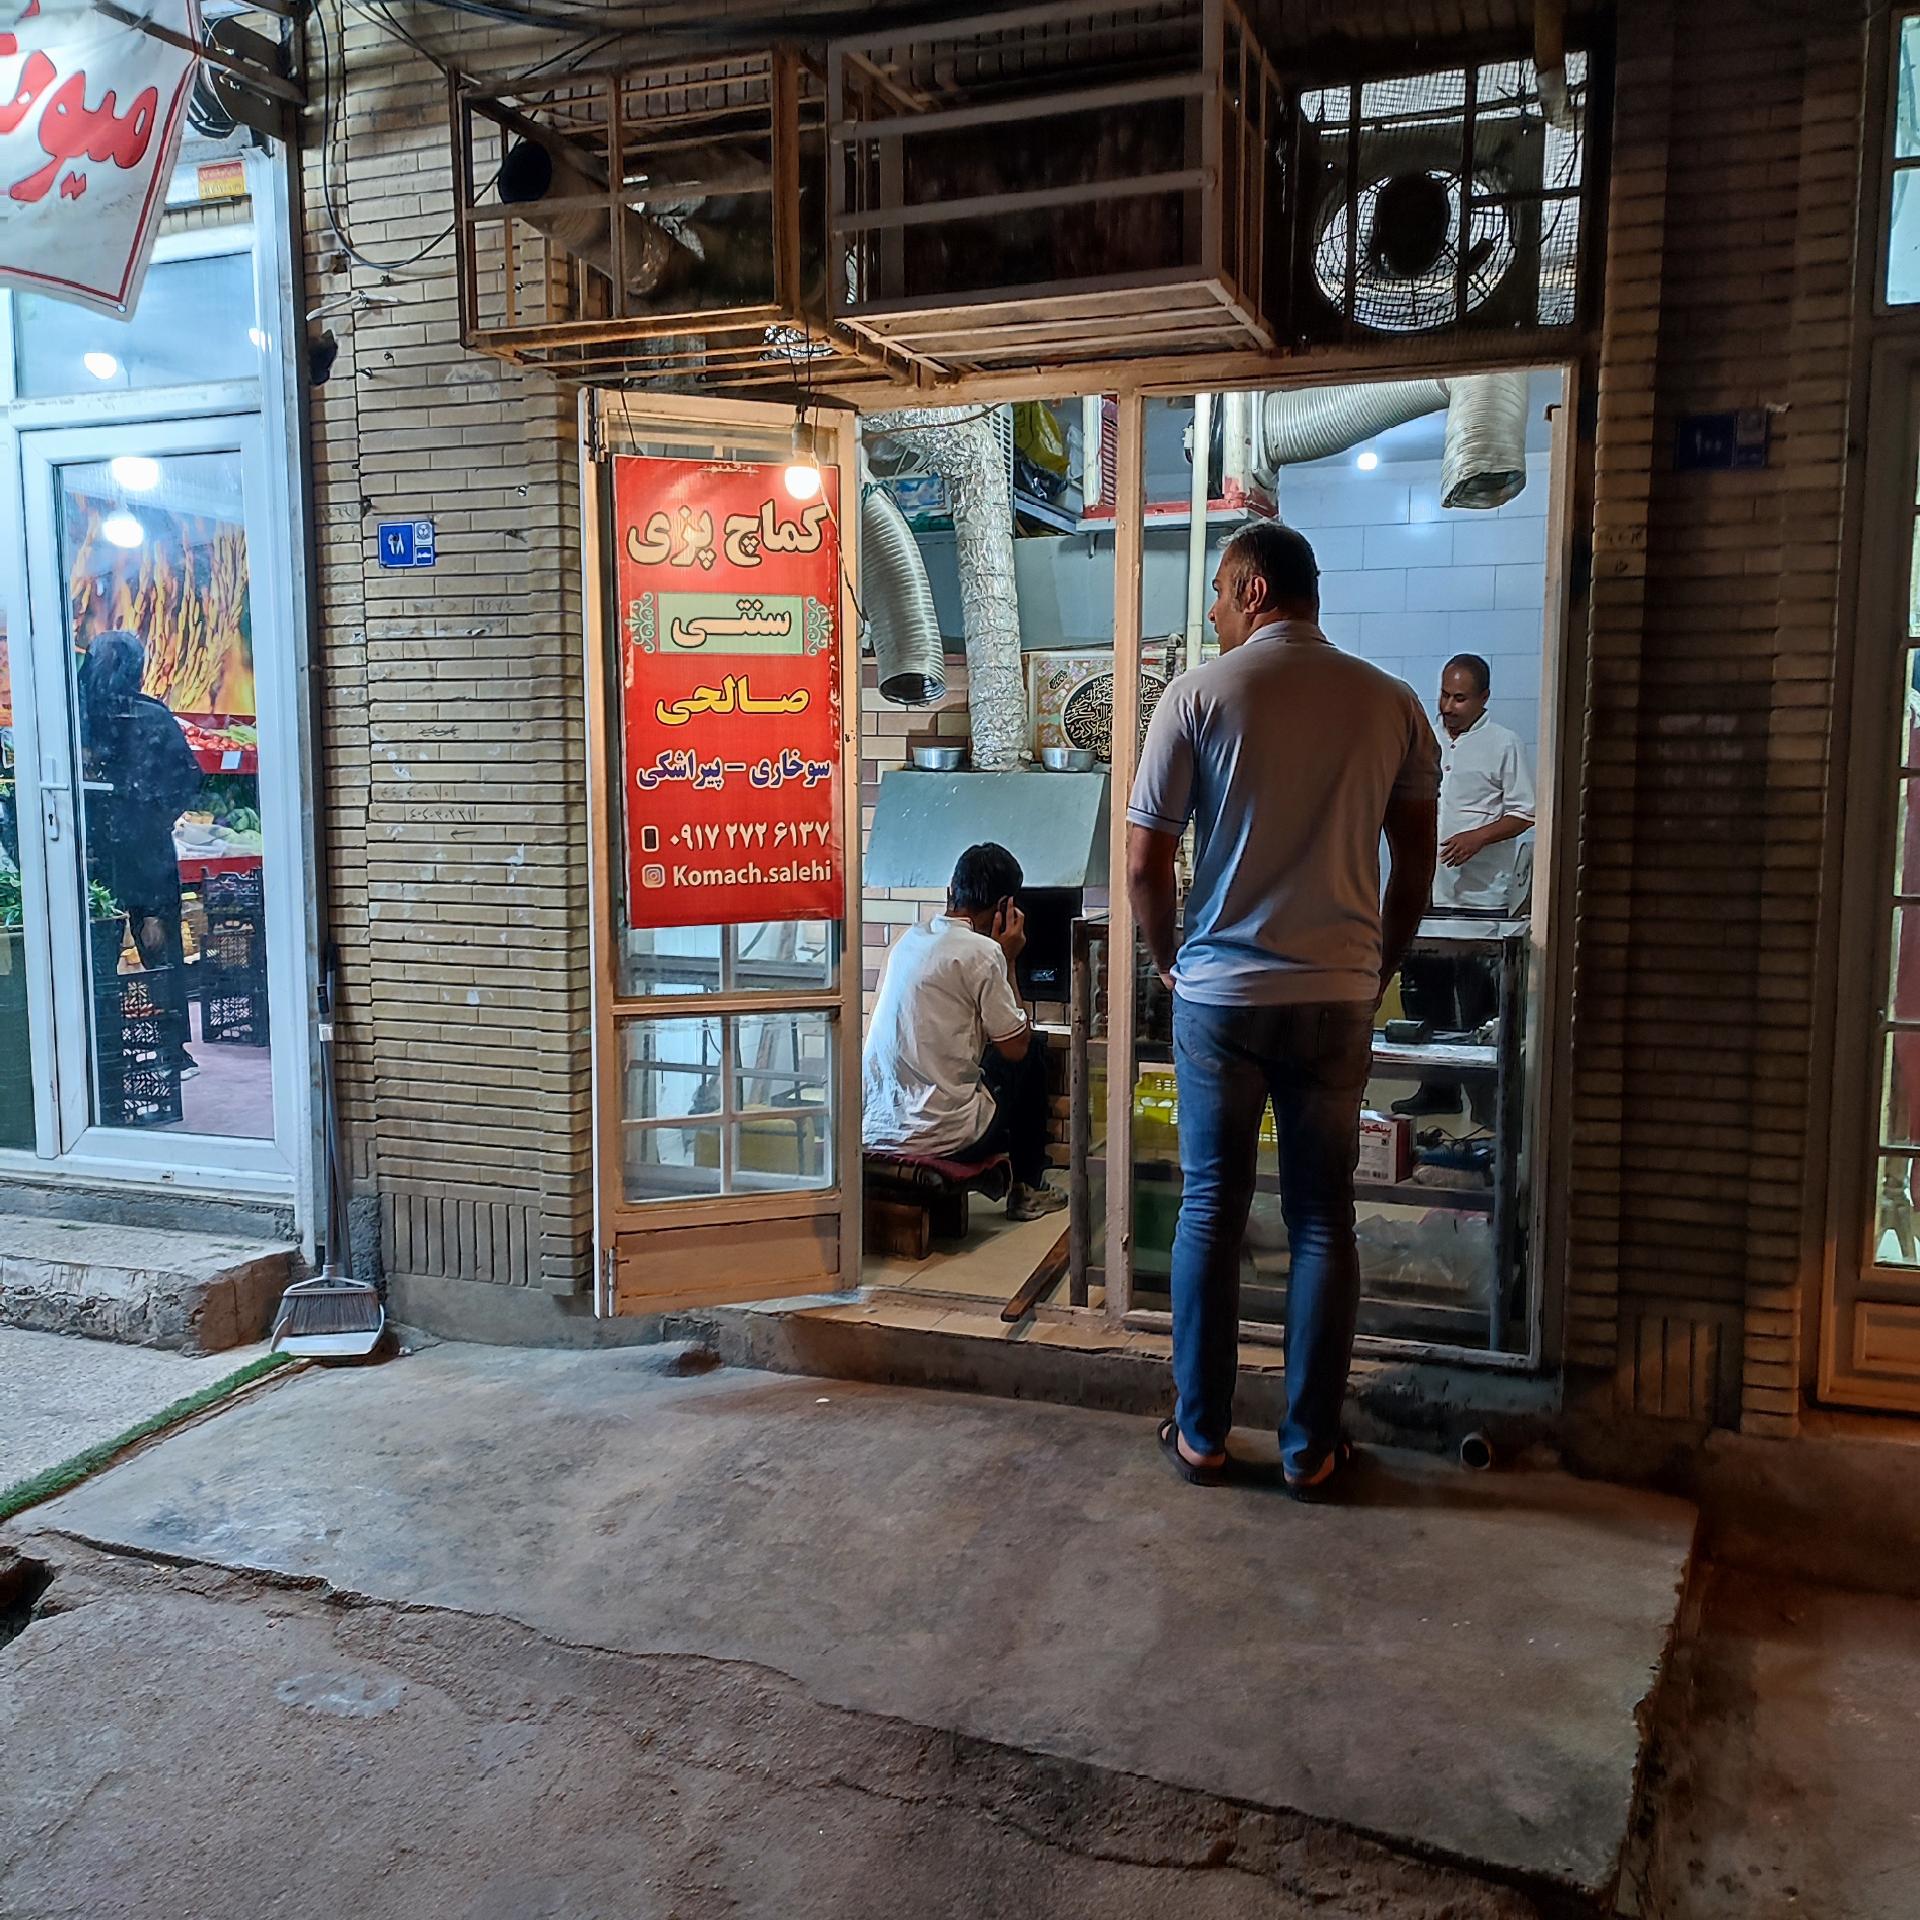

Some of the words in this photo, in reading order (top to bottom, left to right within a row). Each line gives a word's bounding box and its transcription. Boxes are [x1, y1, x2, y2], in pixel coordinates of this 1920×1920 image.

[626, 505, 717, 570] پزی
[724, 498, 829, 568] کماچ
[671, 599, 791, 648] سنتی
[655, 674, 811, 726] صالحی
[637, 748, 723, 790] پیراشکی
[750, 749, 832, 789] سوخاری
[672, 859, 832, 887] Komach.salehi
